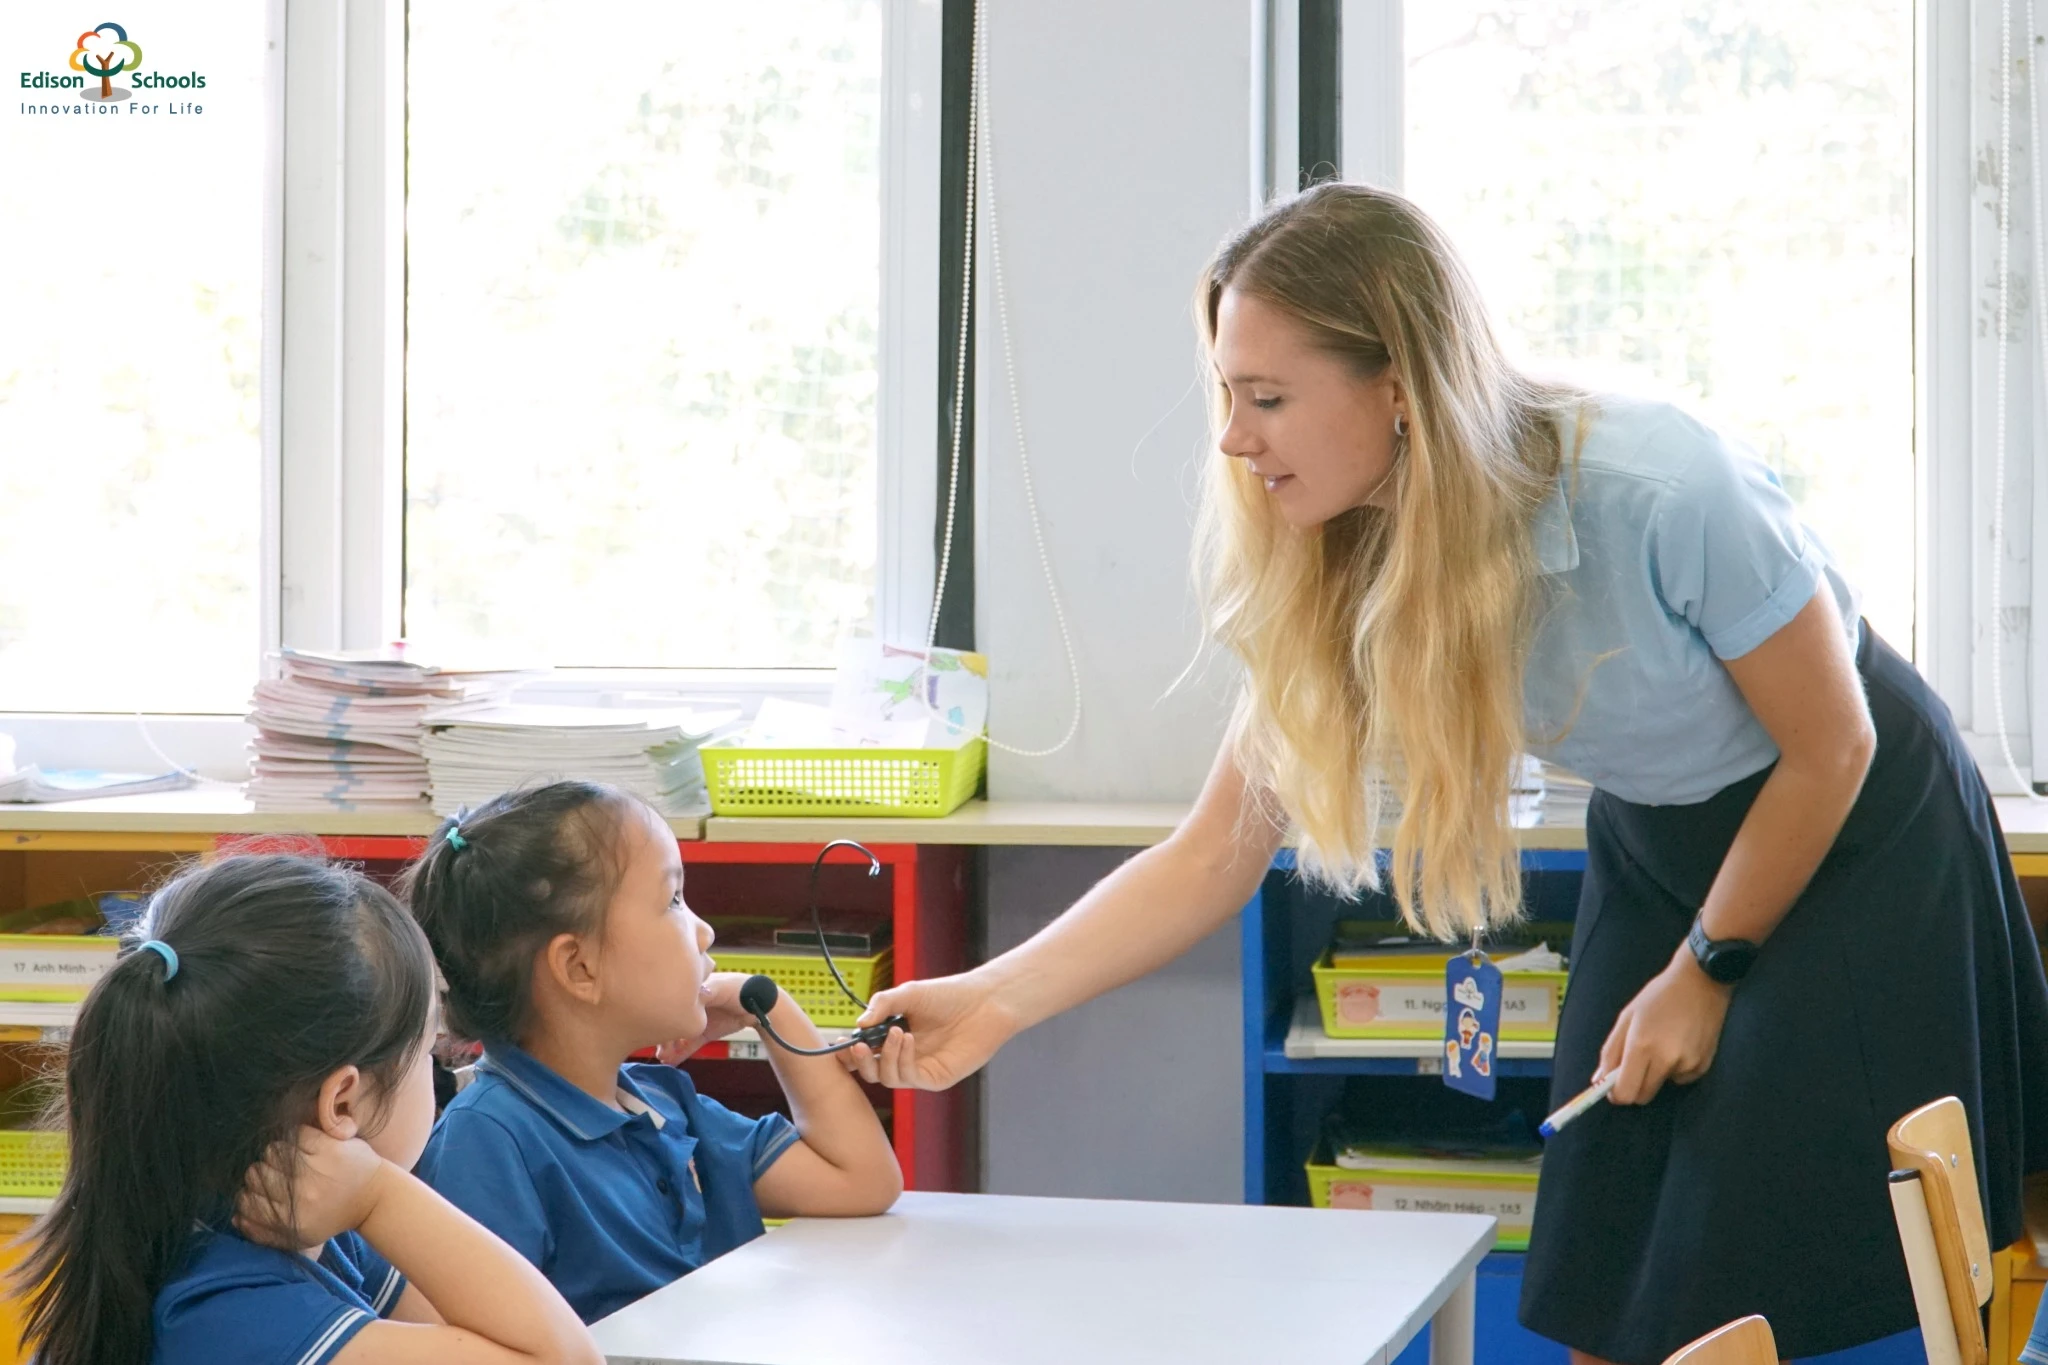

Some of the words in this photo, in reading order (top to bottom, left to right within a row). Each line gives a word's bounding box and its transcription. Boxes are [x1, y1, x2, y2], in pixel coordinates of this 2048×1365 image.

[33, 962, 55, 973] Anh
[58, 962, 87, 974] Minh
[1504, 999, 1526, 1012] 1A3
[1500, 1202, 1522, 1215] 1A3
